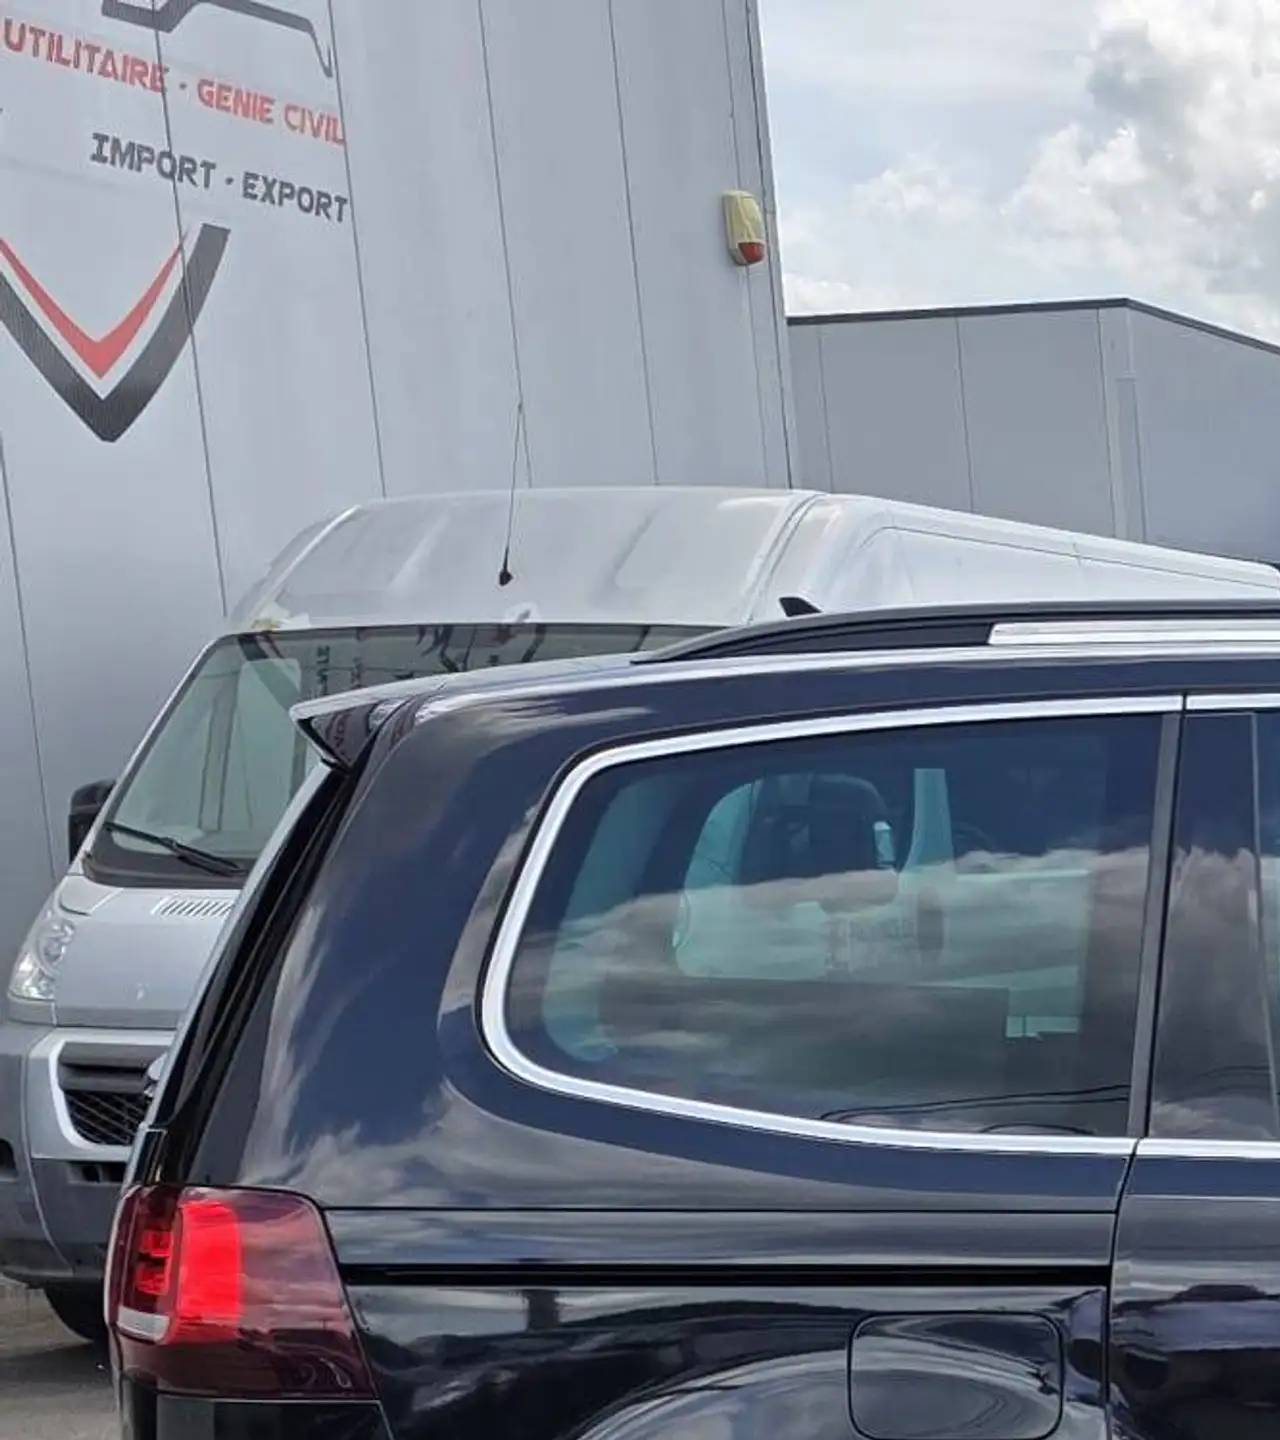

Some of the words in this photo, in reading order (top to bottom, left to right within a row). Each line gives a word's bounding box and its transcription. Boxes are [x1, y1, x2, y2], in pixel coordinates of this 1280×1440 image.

[4, 18, 169, 93] UTILITAIRE
[197, 79, 275, 124] GENIE
[283, 103, 346, 145] CIVIL
[90, 131, 216, 190] IMPORT
[242, 171, 348, 223] EXPORT
